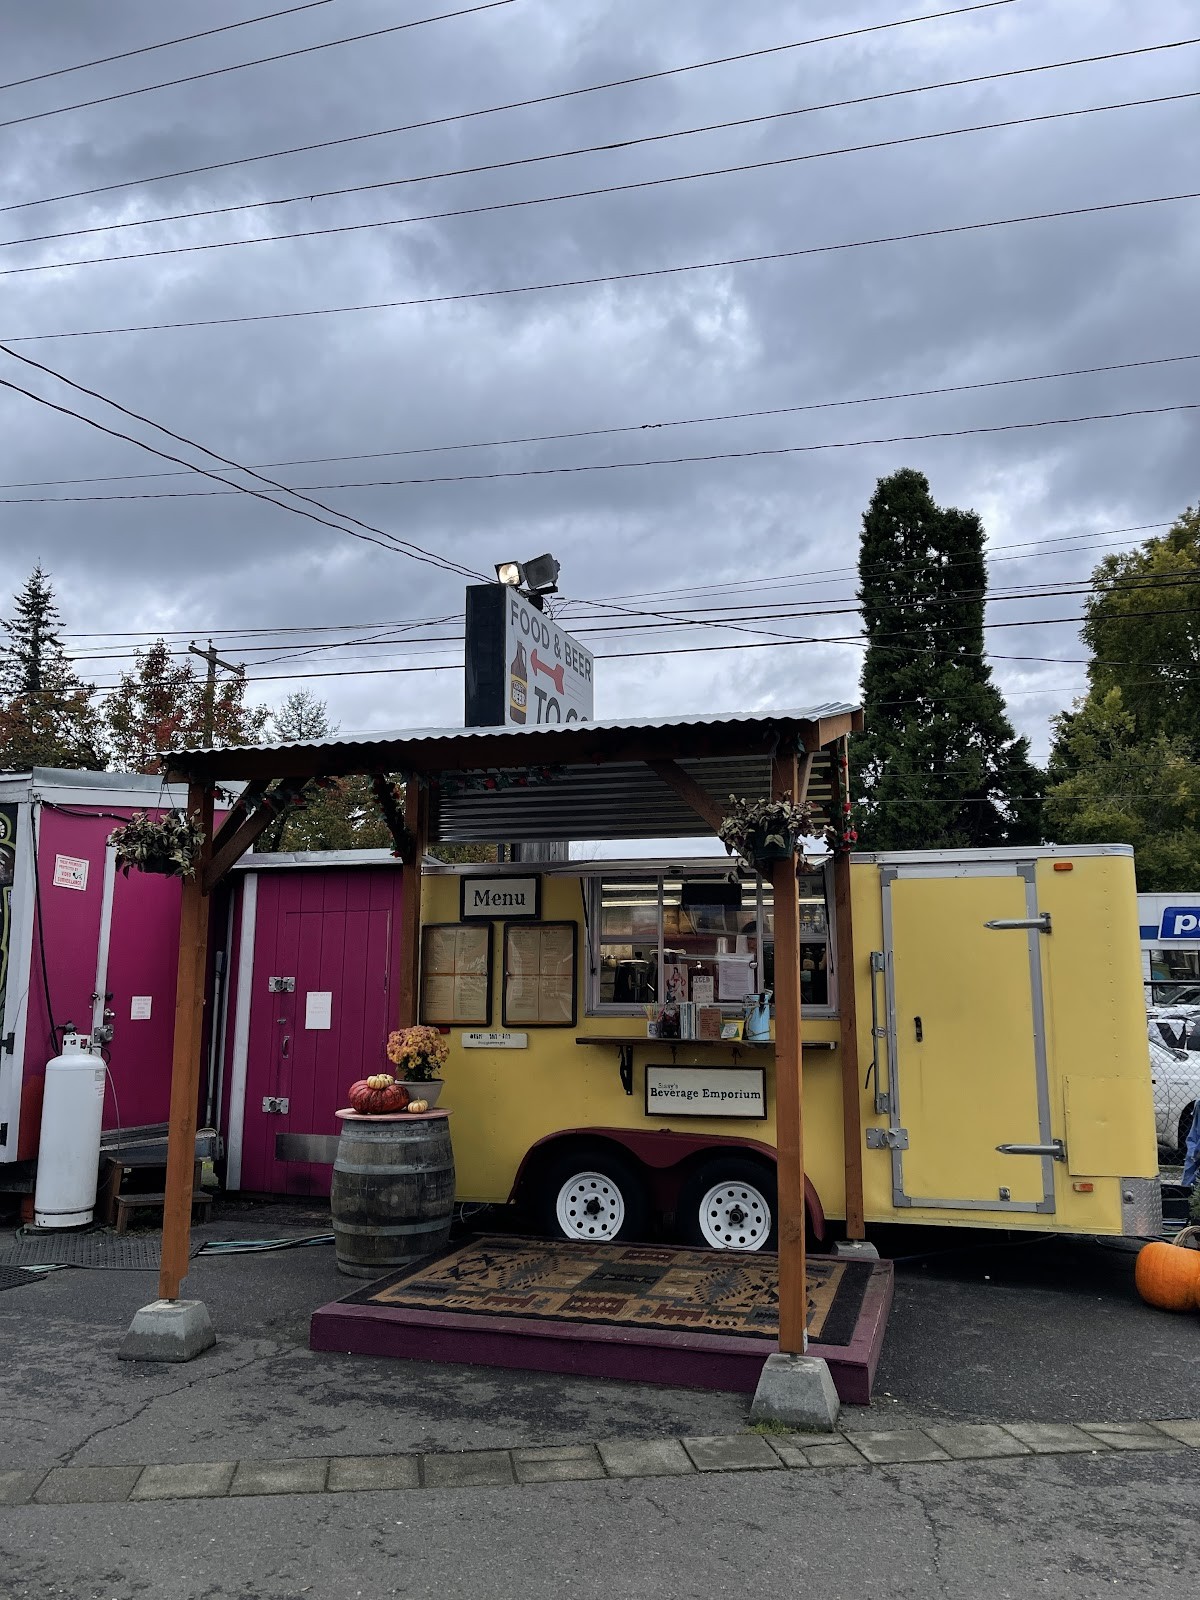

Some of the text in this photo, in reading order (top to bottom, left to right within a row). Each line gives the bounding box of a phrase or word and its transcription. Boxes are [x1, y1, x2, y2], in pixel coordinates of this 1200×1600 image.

[511, 600, 592, 682] FOOD & BEER
[473, 889, 526, 907] Menu
[650, 1087, 761, 1101] Beverage Emporium
